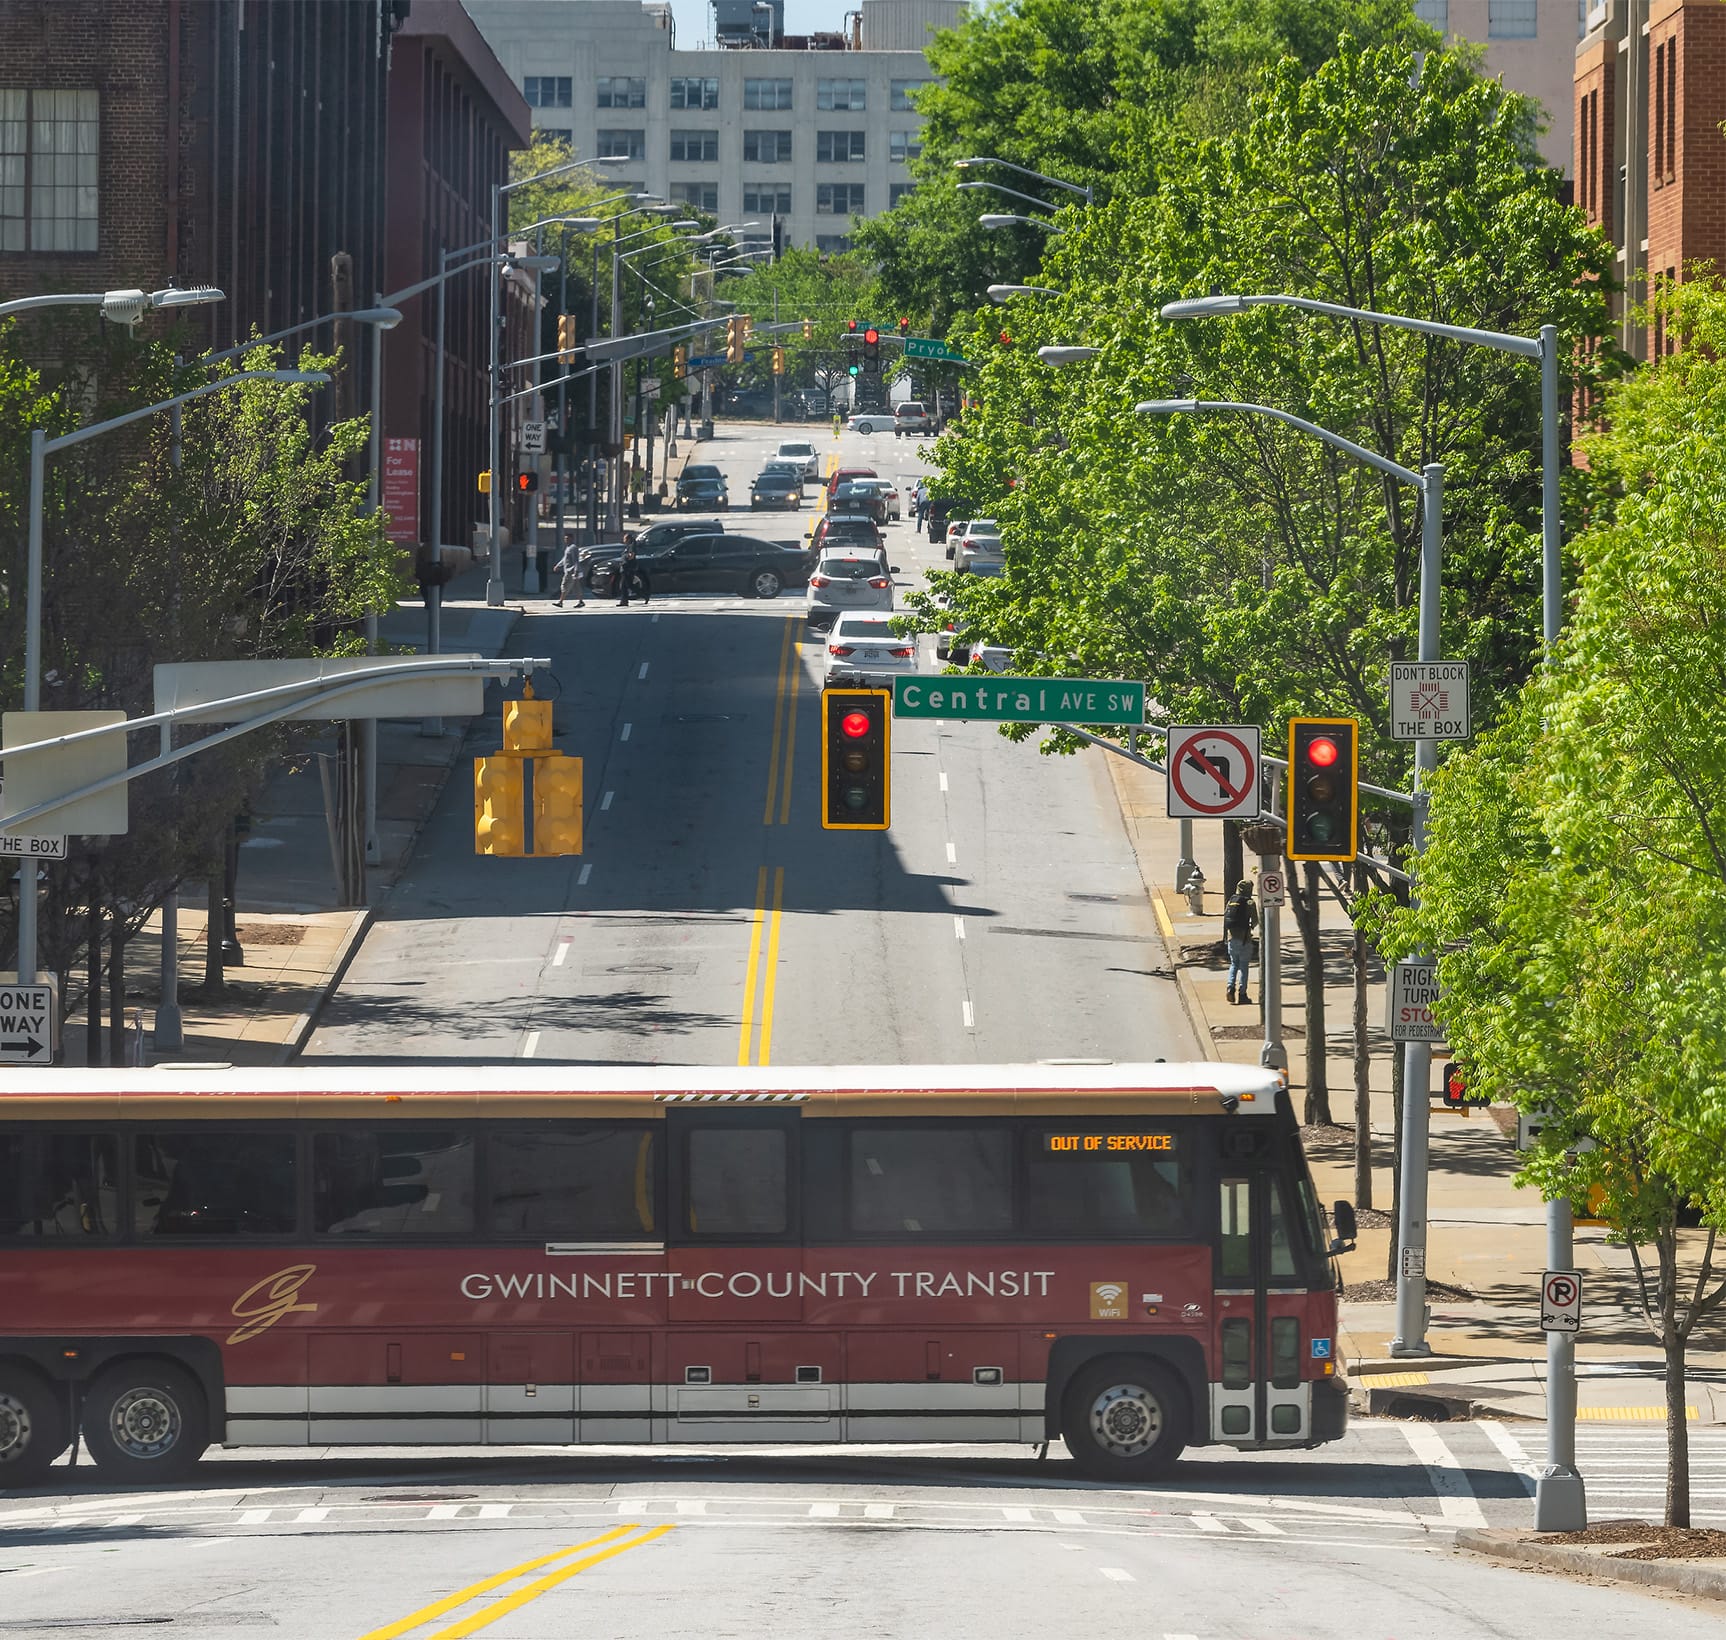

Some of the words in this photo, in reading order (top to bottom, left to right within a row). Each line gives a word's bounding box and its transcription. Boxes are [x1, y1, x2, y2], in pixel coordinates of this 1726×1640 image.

[526, 423, 542, 431] ONE
[525, 433, 541, 441] WAY
[386, 456, 402, 465] For
[386, 467, 413, 476] Lease
[1395, 667, 1426, 680] DON'T
[1429, 667, 1464, 680] BLOCK
[903, 685, 1046, 711] Central
[1060, 692, 1097, 710] AVE
[1107, 694, 1134, 712] SW
[1398, 721, 1426, 735] THE
[1434, 721, 1462, 735] BOX
[30, 839, 59, 853] BOX
[1403, 968, 1438, 986] RIGH
[0, 992, 45, 1010] ONE
[1403, 988, 1439, 1004] TURN
[1400, 1007, 1437, 1023] STO
[0, 1015, 45, 1033] WAY
[1394, 1025, 1407, 1036] FOR
[1050, 1136, 1080, 1151] OUT
[1083, 1136, 1103, 1151] OF
[1106, 1135, 1172, 1151] SERVICE
[460, 1272, 682, 1299] GWINNETT
[696, 1272, 877, 1298] COUNTY
[890, 1271, 1055, 1297] TRANSIT
[1098, 1308, 1121, 1317] WiFi
